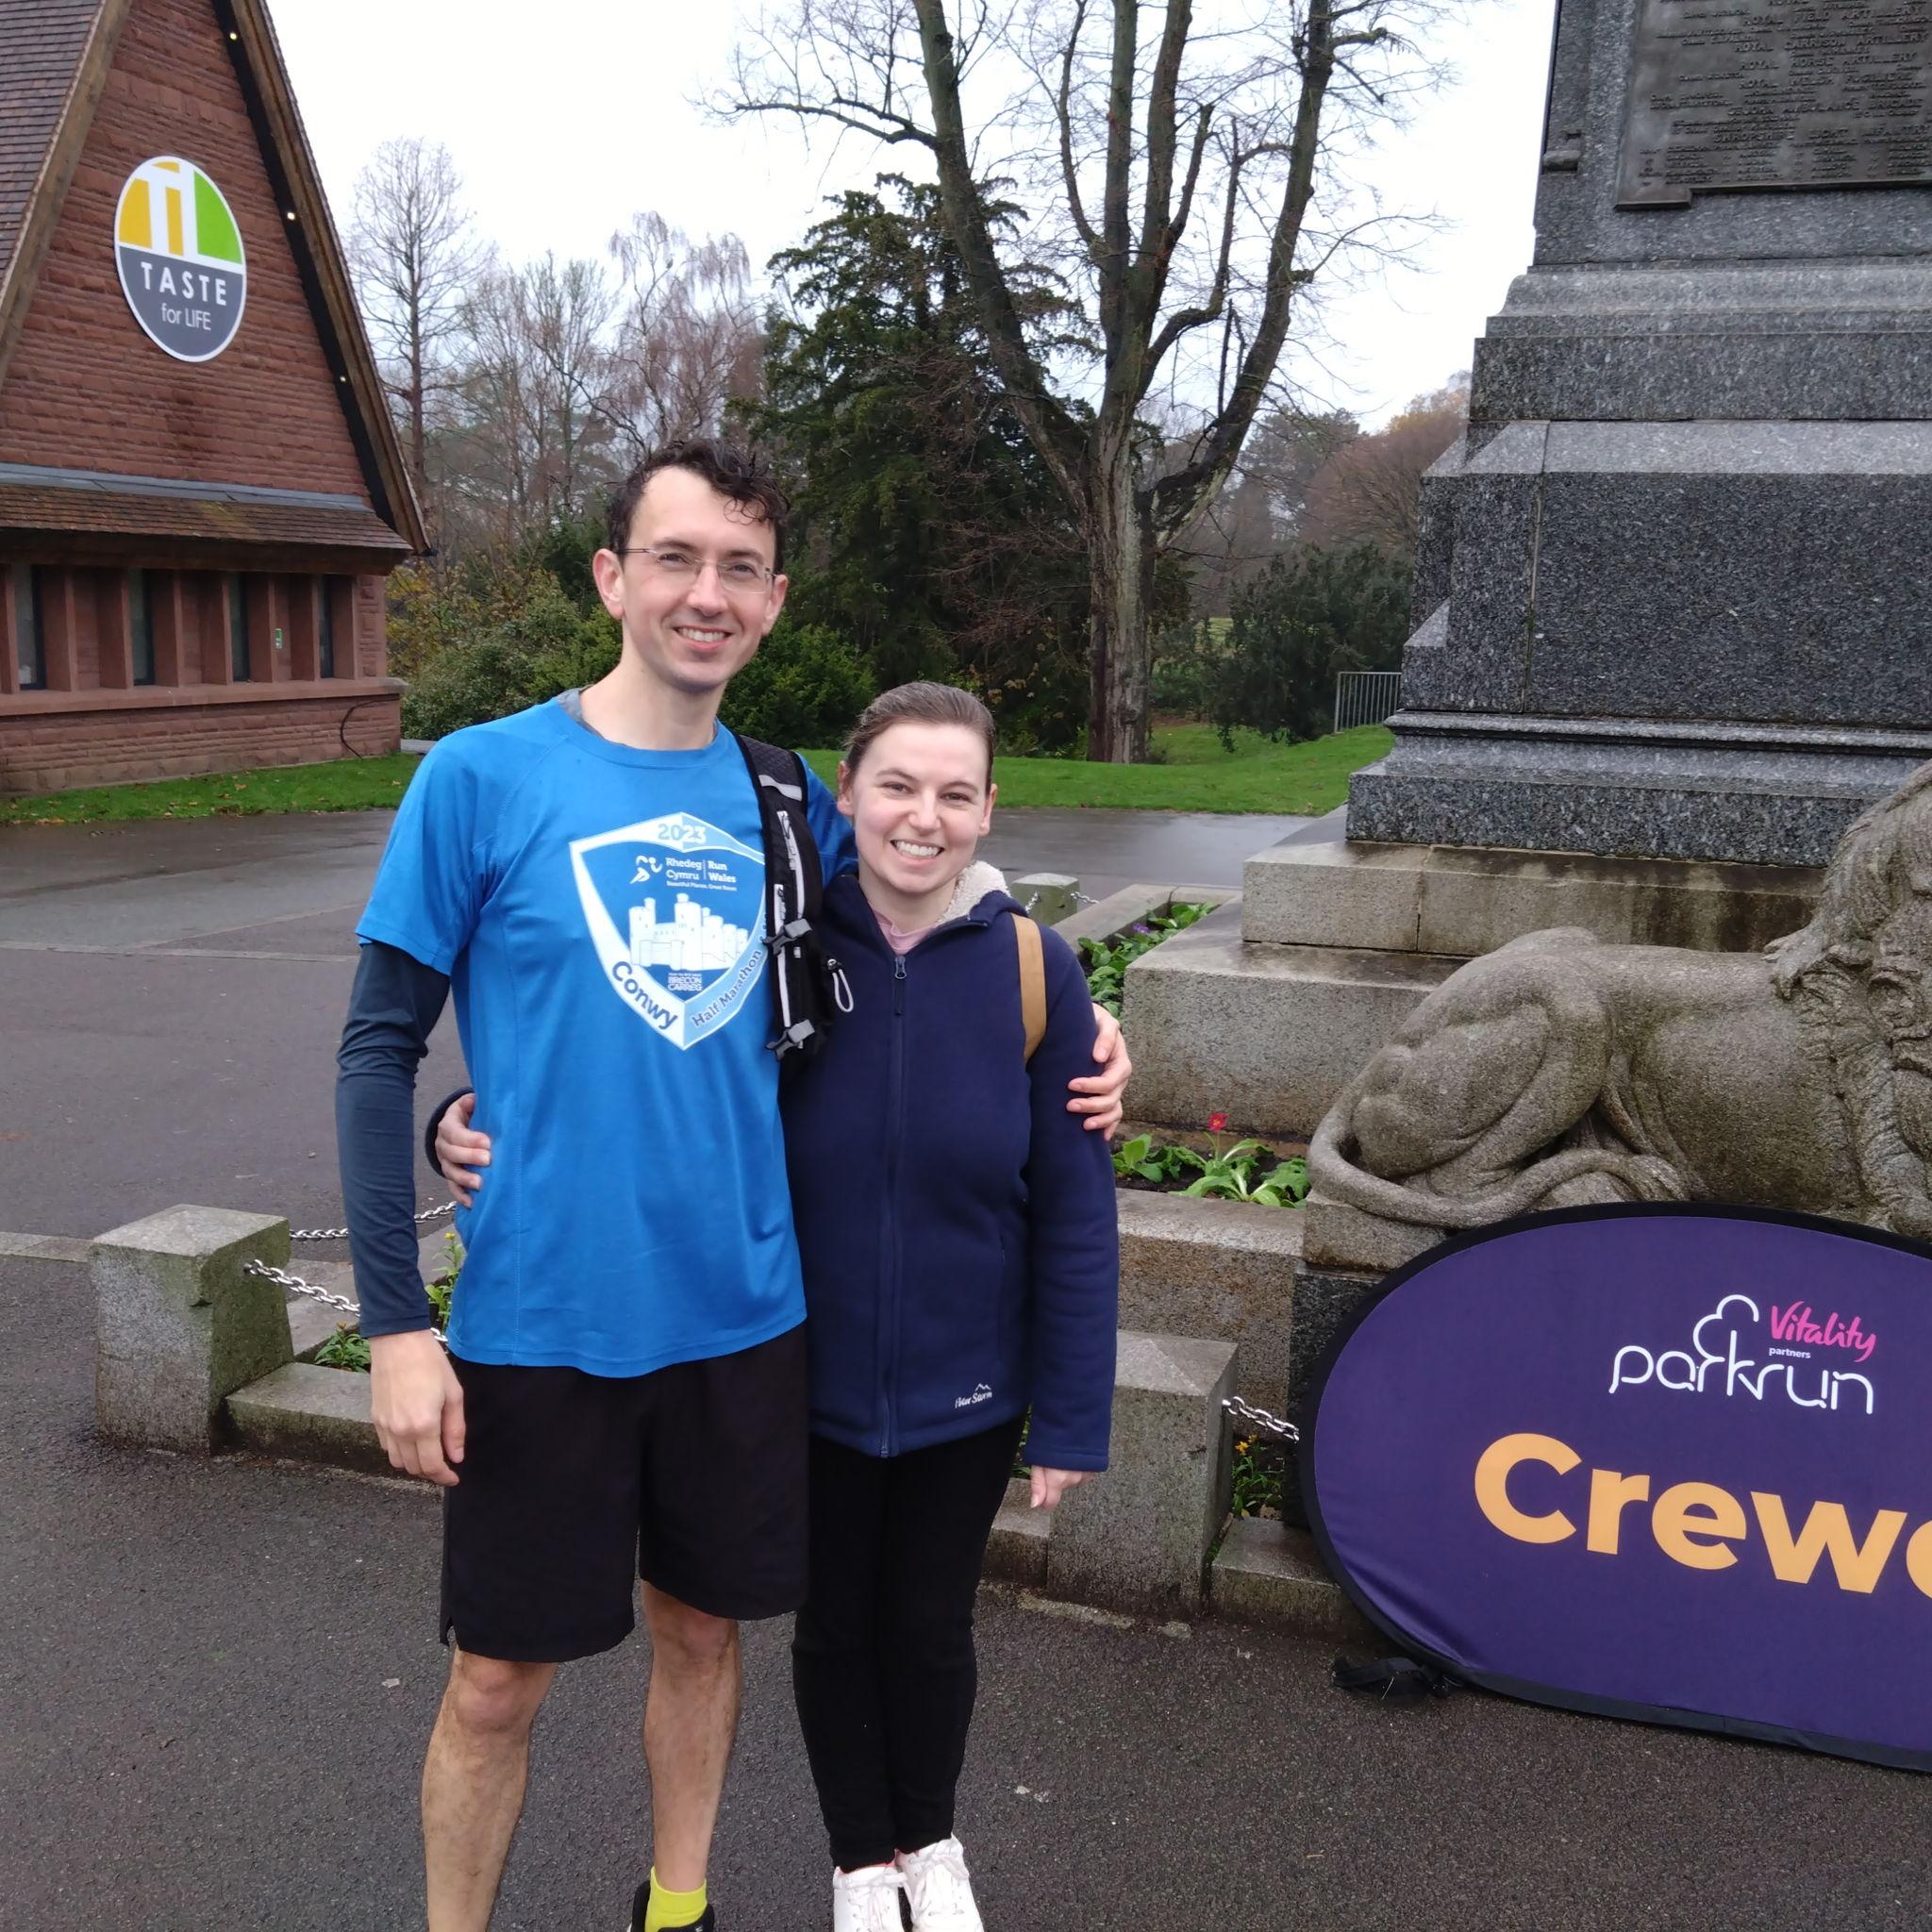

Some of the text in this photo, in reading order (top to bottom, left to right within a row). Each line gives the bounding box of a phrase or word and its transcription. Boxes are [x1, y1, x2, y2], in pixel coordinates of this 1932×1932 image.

[1734, 41, 1774, 53] ROYAL
[1784, 37, 1846, 51] GARRISON
[1857, 32, 1930, 47] ARTILLERY
[141, 261, 227, 307] TASTE
[161, 303, 211, 330] for LIFE
[658, 823, 707, 844] 2023
[665, 857, 702, 871] Rhedeg
[665, 869, 700, 880] Cymru
[708, 859, 728, 871] Run
[708, 872, 737, 883] Wales
[612, 960, 679, 1030] Conwy
[691, 949, 762, 1027] Half Marathon
[1770, 1300, 1877, 1362] Vitality
[1608, 1294, 1874, 1415] parkrun
[1768, 1344, 1811, 1360] partners
[1474, 1432, 1932, 1600] Crew
